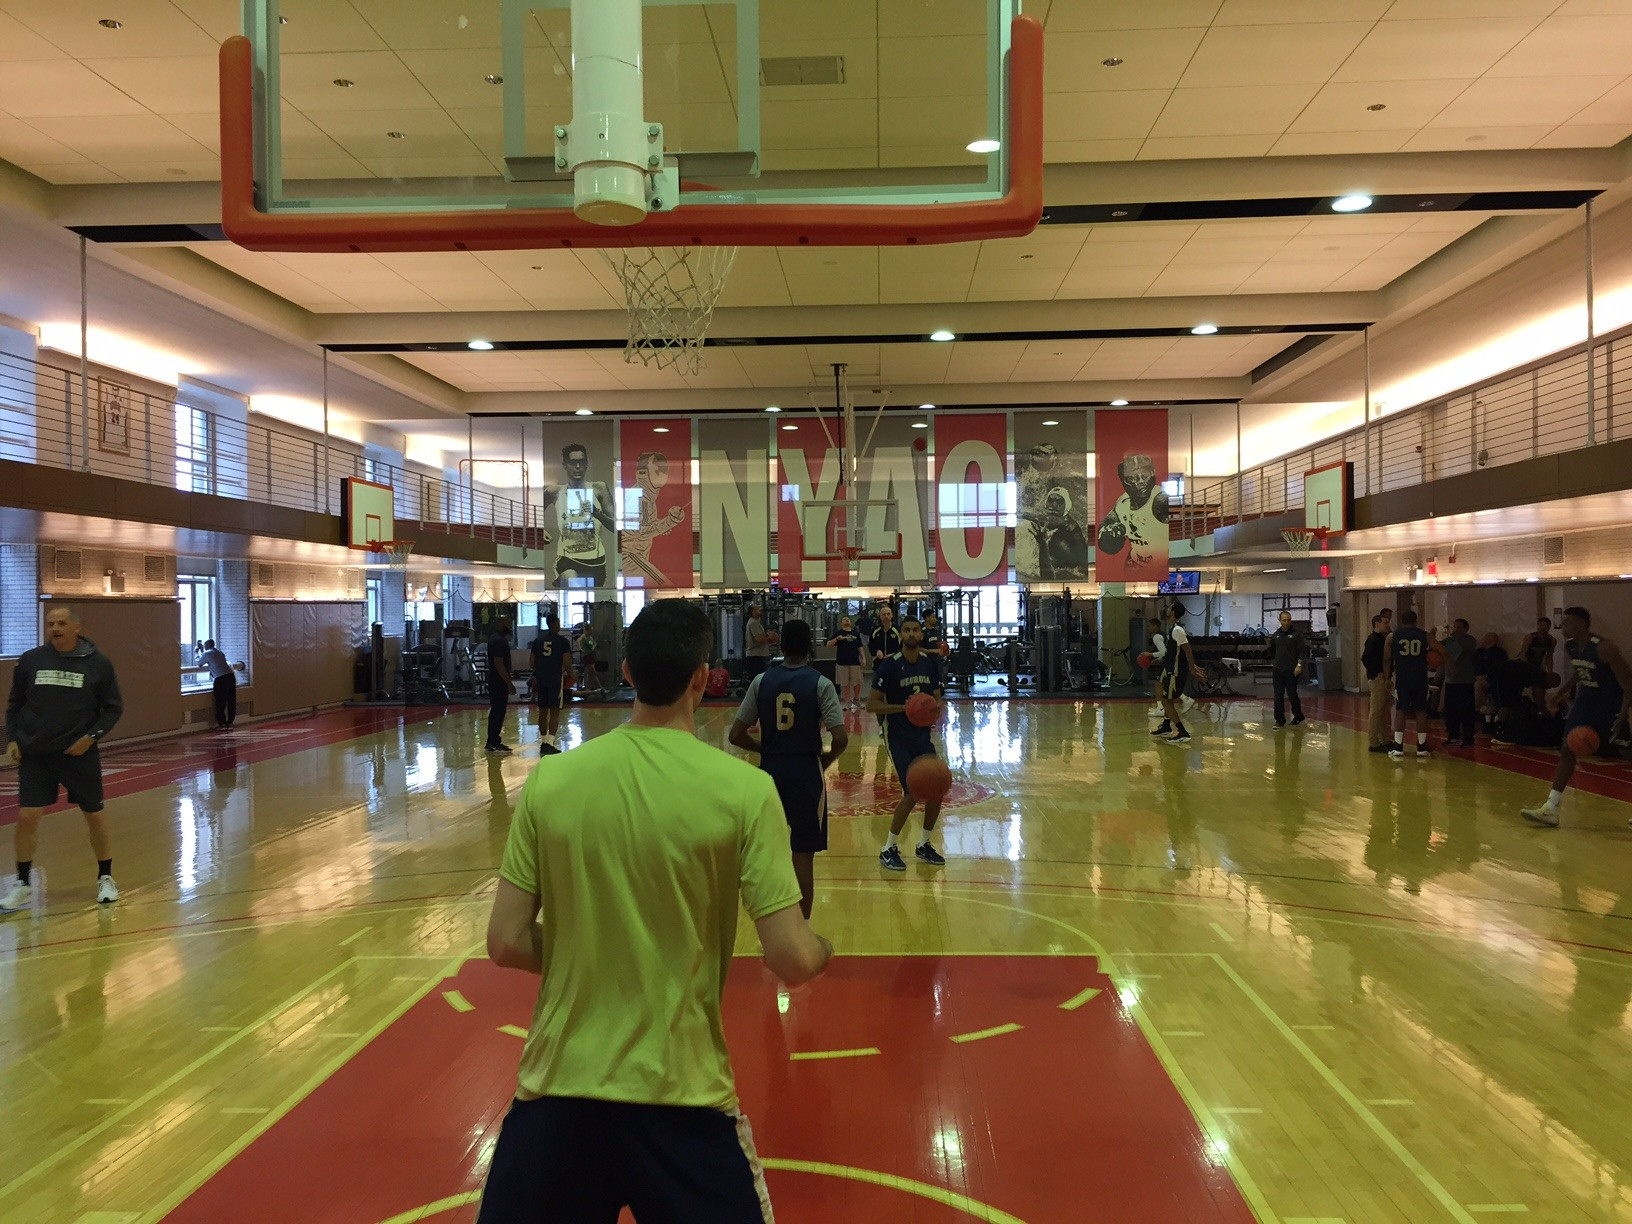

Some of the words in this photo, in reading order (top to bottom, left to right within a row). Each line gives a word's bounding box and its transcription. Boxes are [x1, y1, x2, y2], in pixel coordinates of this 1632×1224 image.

[700, 440, 1006, 582] NYAC
[542, 640, 553, 657] 5
[1398, 638, 1422, 656] 30
[775, 692, 796, 731] 6
